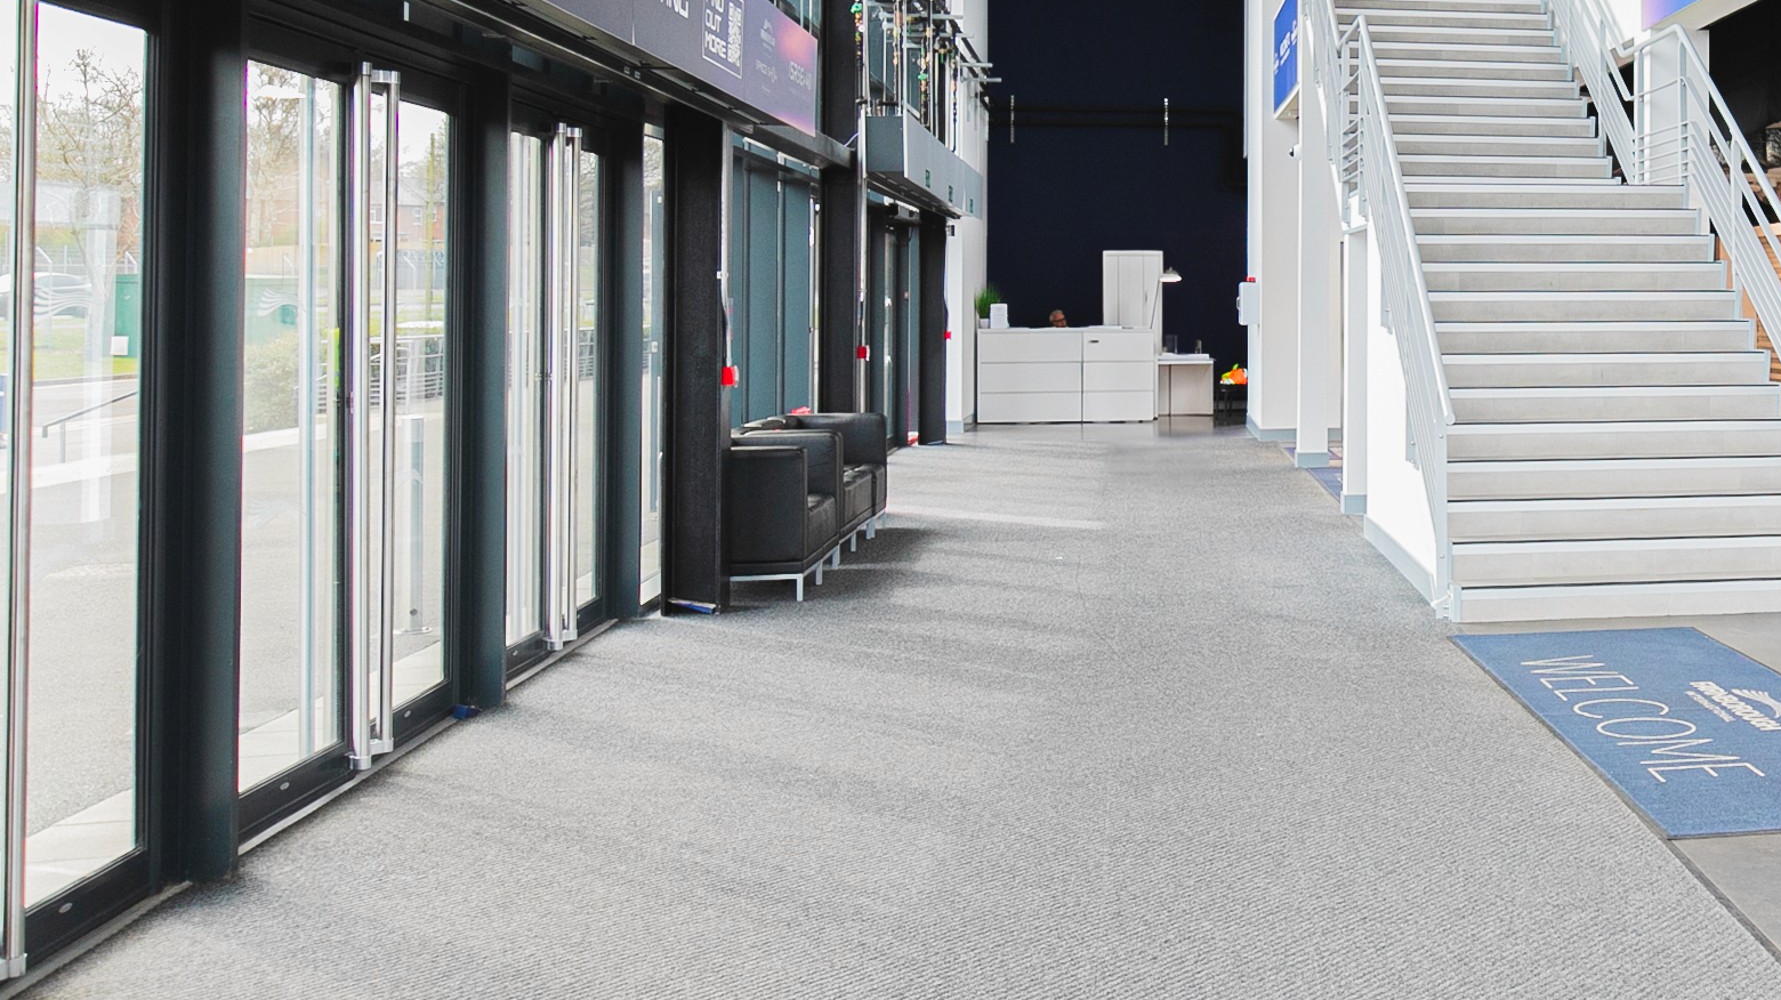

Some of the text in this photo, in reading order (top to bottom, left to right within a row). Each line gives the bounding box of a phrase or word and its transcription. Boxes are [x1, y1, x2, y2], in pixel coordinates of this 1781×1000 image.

[705, 8, 722, 33] OUT
[704, 31, 727, 59] MORE
[1520, 654, 1766, 783] WELCOME
